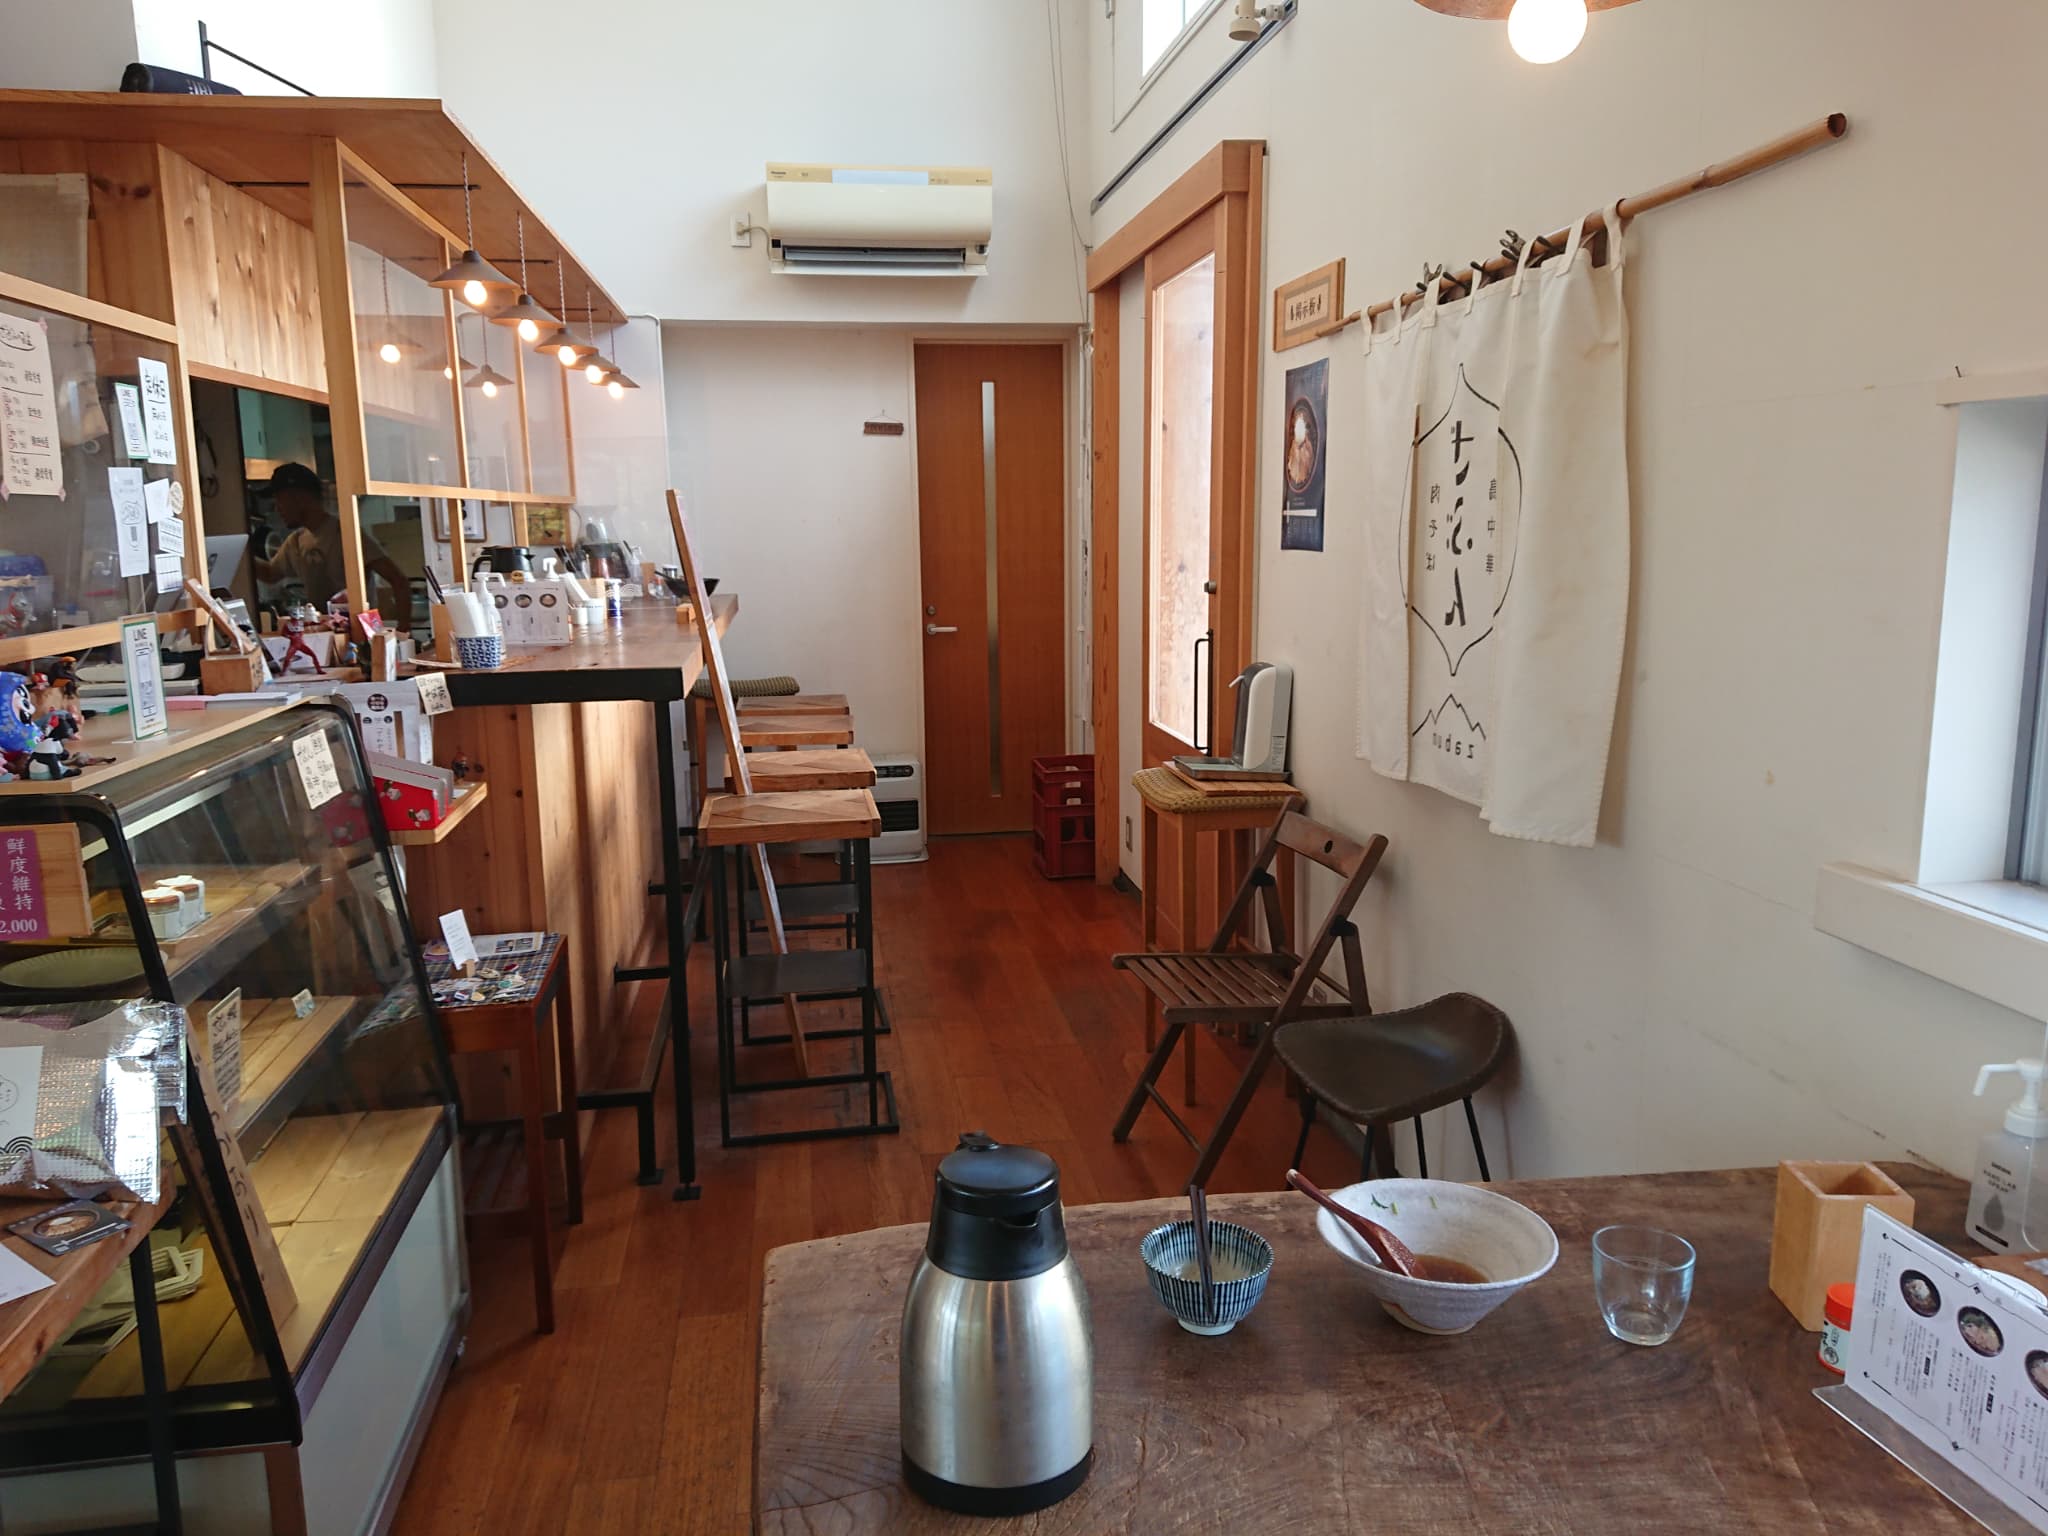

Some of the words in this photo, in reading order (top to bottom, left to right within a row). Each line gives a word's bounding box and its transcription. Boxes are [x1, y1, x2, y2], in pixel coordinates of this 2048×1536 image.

[133, 628, 148, 641] LINE
[7, 838, 33, 911] 鮮度維持
